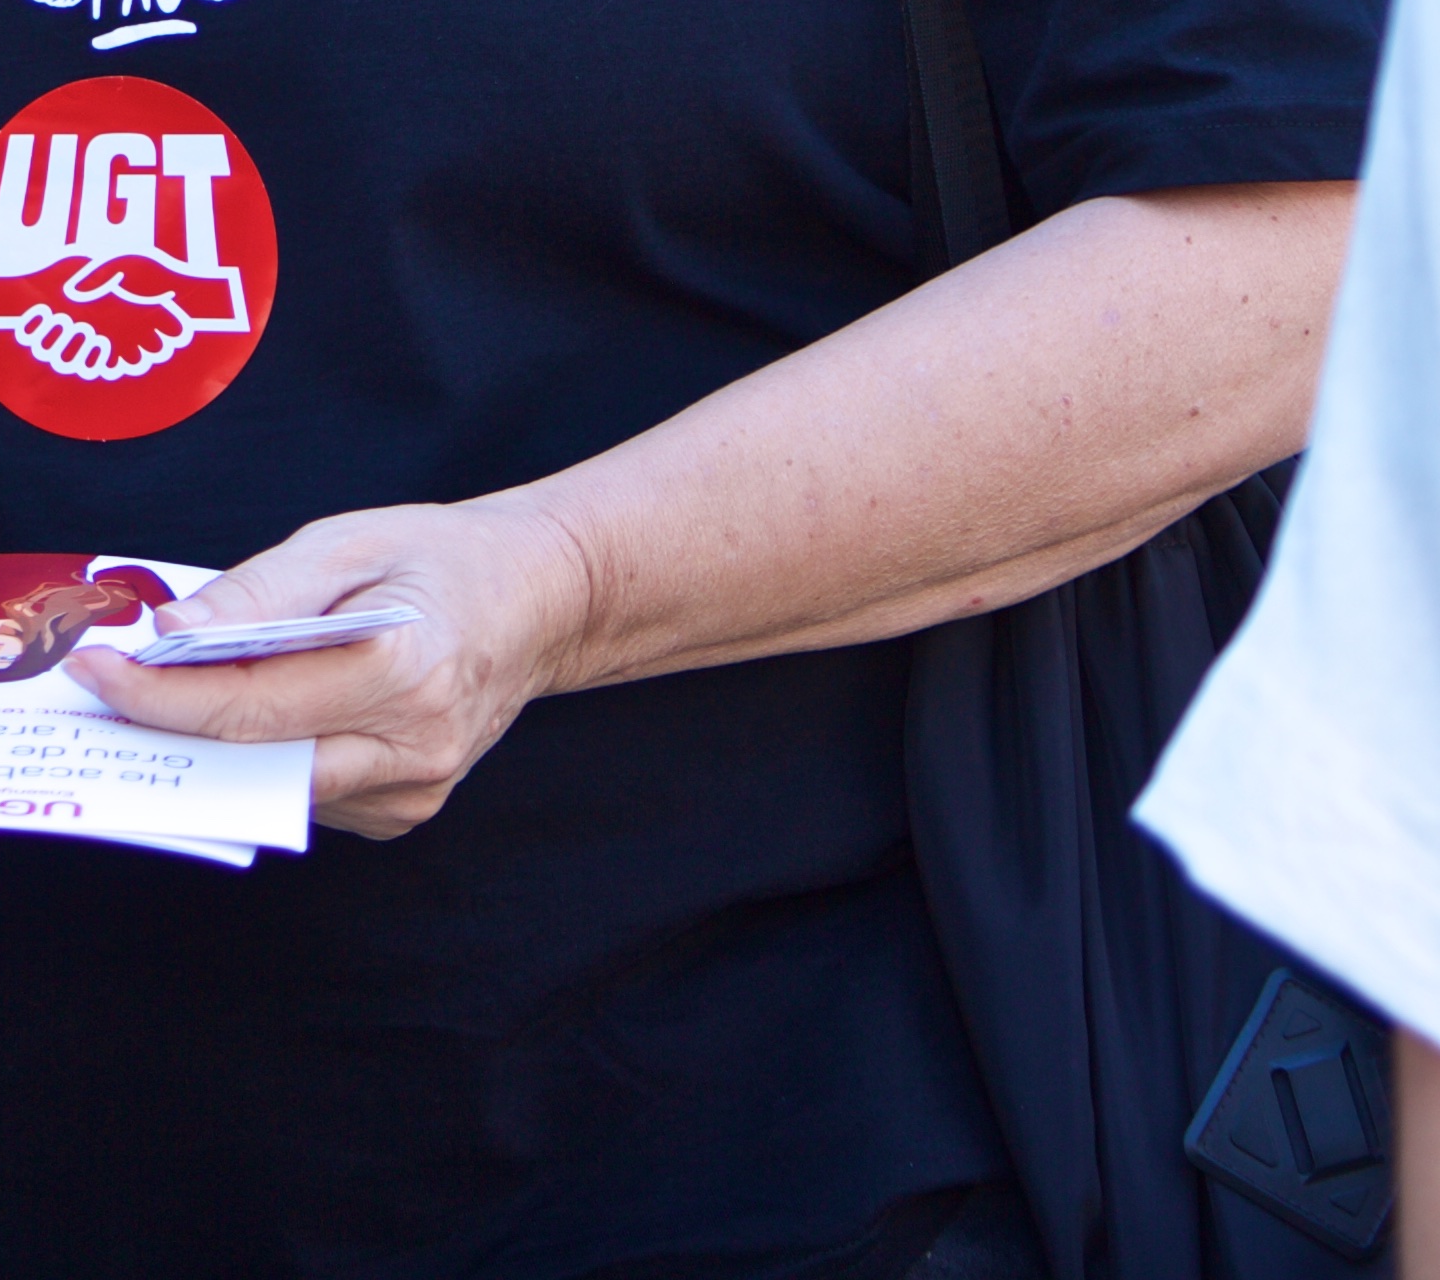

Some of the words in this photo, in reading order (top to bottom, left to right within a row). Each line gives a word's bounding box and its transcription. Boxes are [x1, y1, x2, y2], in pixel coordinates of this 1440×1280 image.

[11, 746, 66, 760] de
[84, 748, 194, 769] Grau
[118, 770, 182, 787] He
